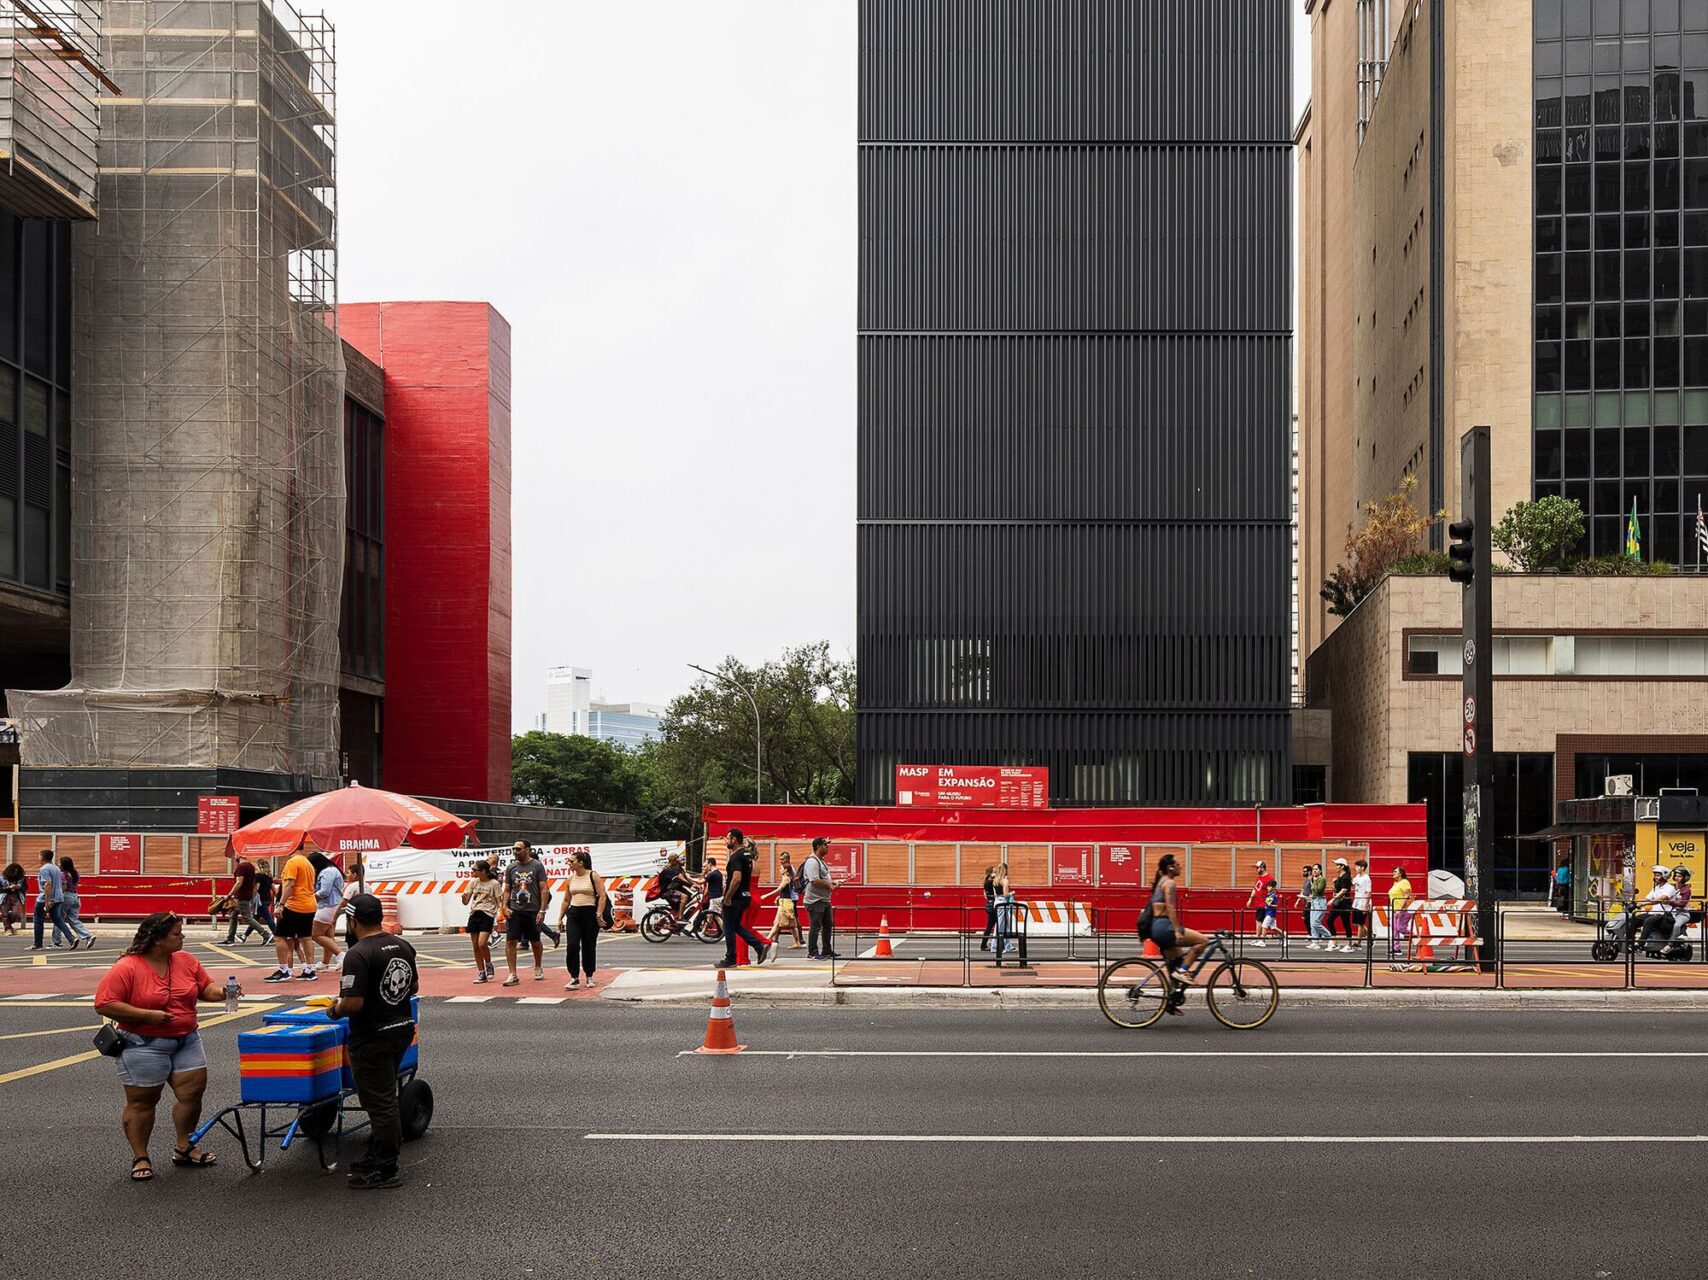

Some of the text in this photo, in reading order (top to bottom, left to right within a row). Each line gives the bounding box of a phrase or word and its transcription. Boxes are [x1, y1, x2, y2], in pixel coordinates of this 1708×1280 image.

[1466, 702, 1474, 716] 50
[899, 767, 953, 777] MASP EM
[938, 776, 995, 787] EXPANSÃO
[339, 839, 380, 850] BRAHMA
[1668, 840, 1695, 854] veja
[553, 846, 591, 855] OBRAS
